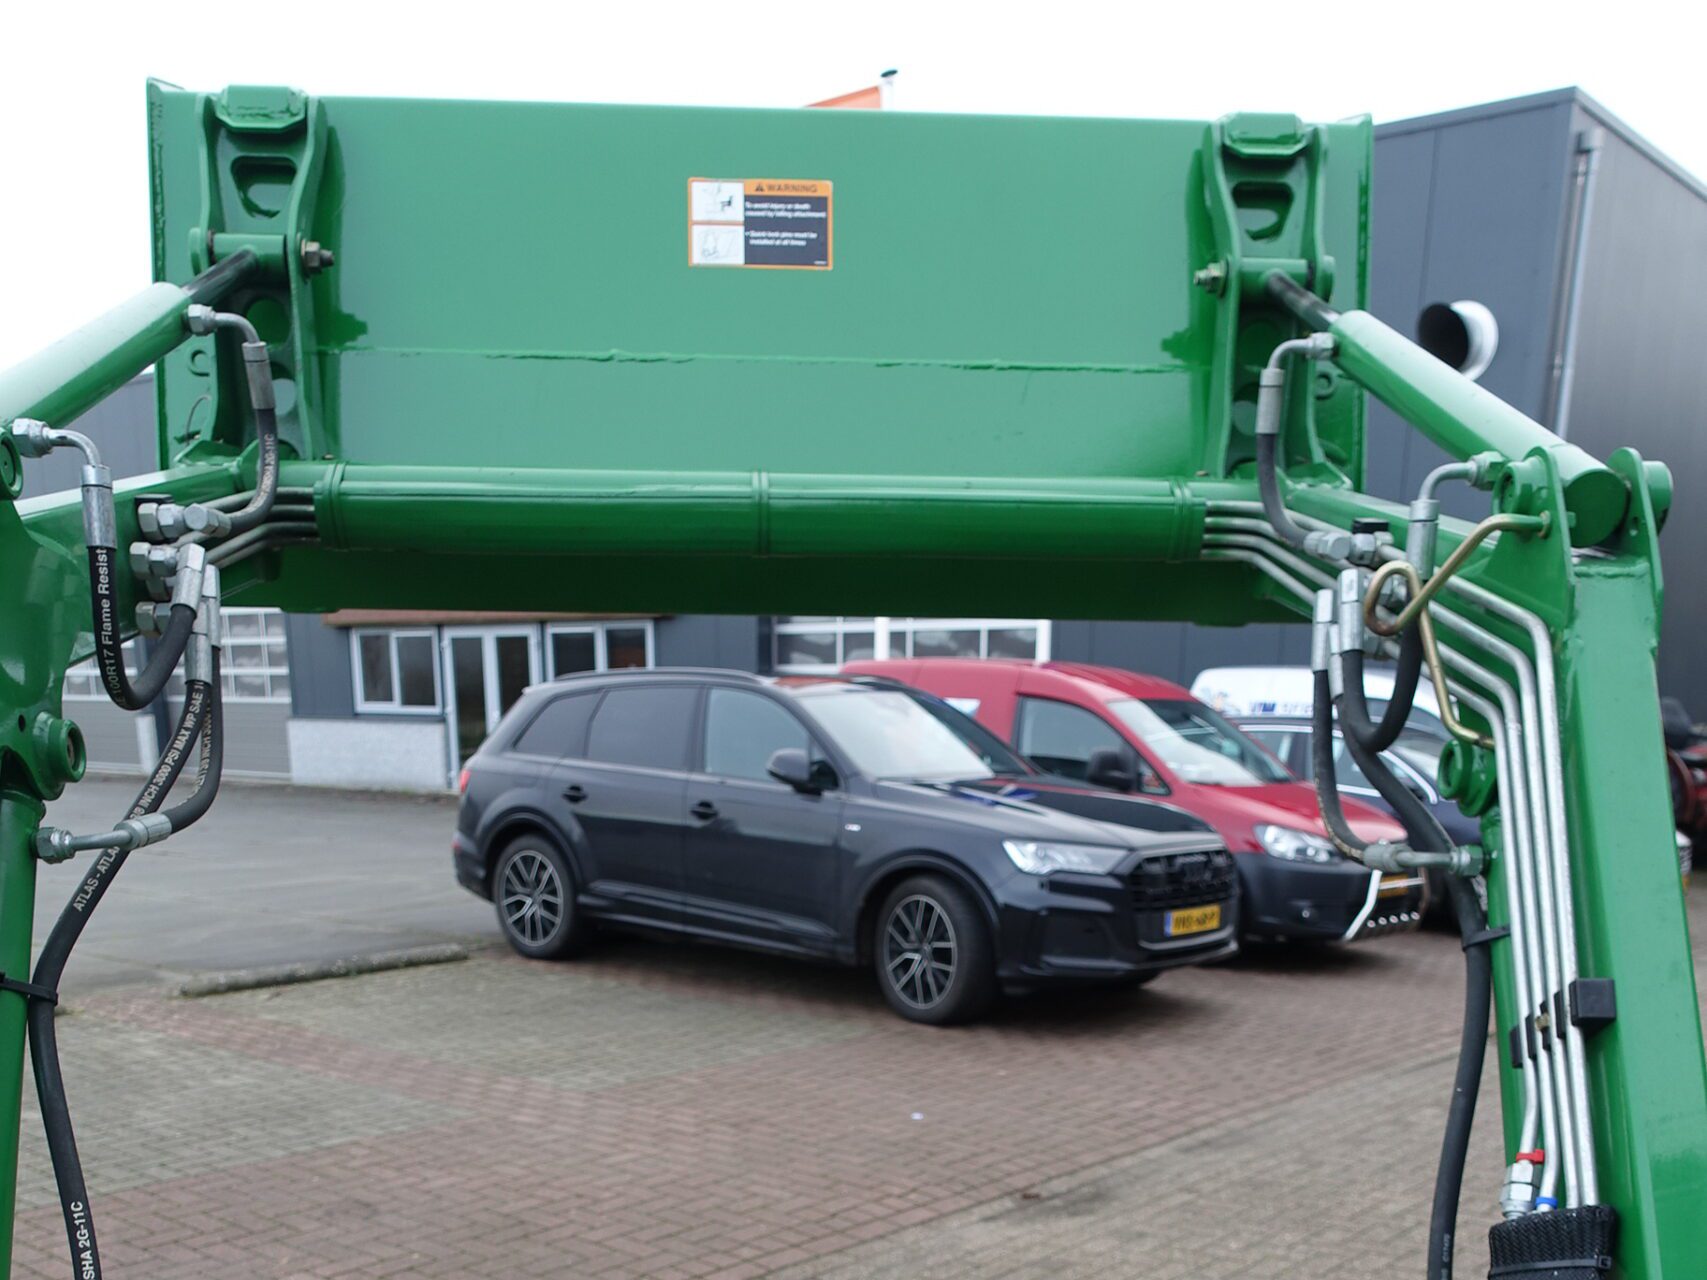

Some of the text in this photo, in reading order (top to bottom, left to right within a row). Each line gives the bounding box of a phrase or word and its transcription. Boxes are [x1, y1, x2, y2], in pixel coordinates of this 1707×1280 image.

[766, 183, 818, 193] WARNING
[95, 548, 110, 595] Resist
[99, 598, 114, 645] Flame
[189, 691, 204, 713] SAE
[183, 712, 198, 728] WP
[175, 727, 191, 750] MAX
[164, 749, 181, 766] PSI
[153, 764, 172, 786] 3000
[137, 783, 159, 807] INCH
[72, 877, 99, 912] ATLAS
[70, 1201, 91, 1248] 2G-11C
